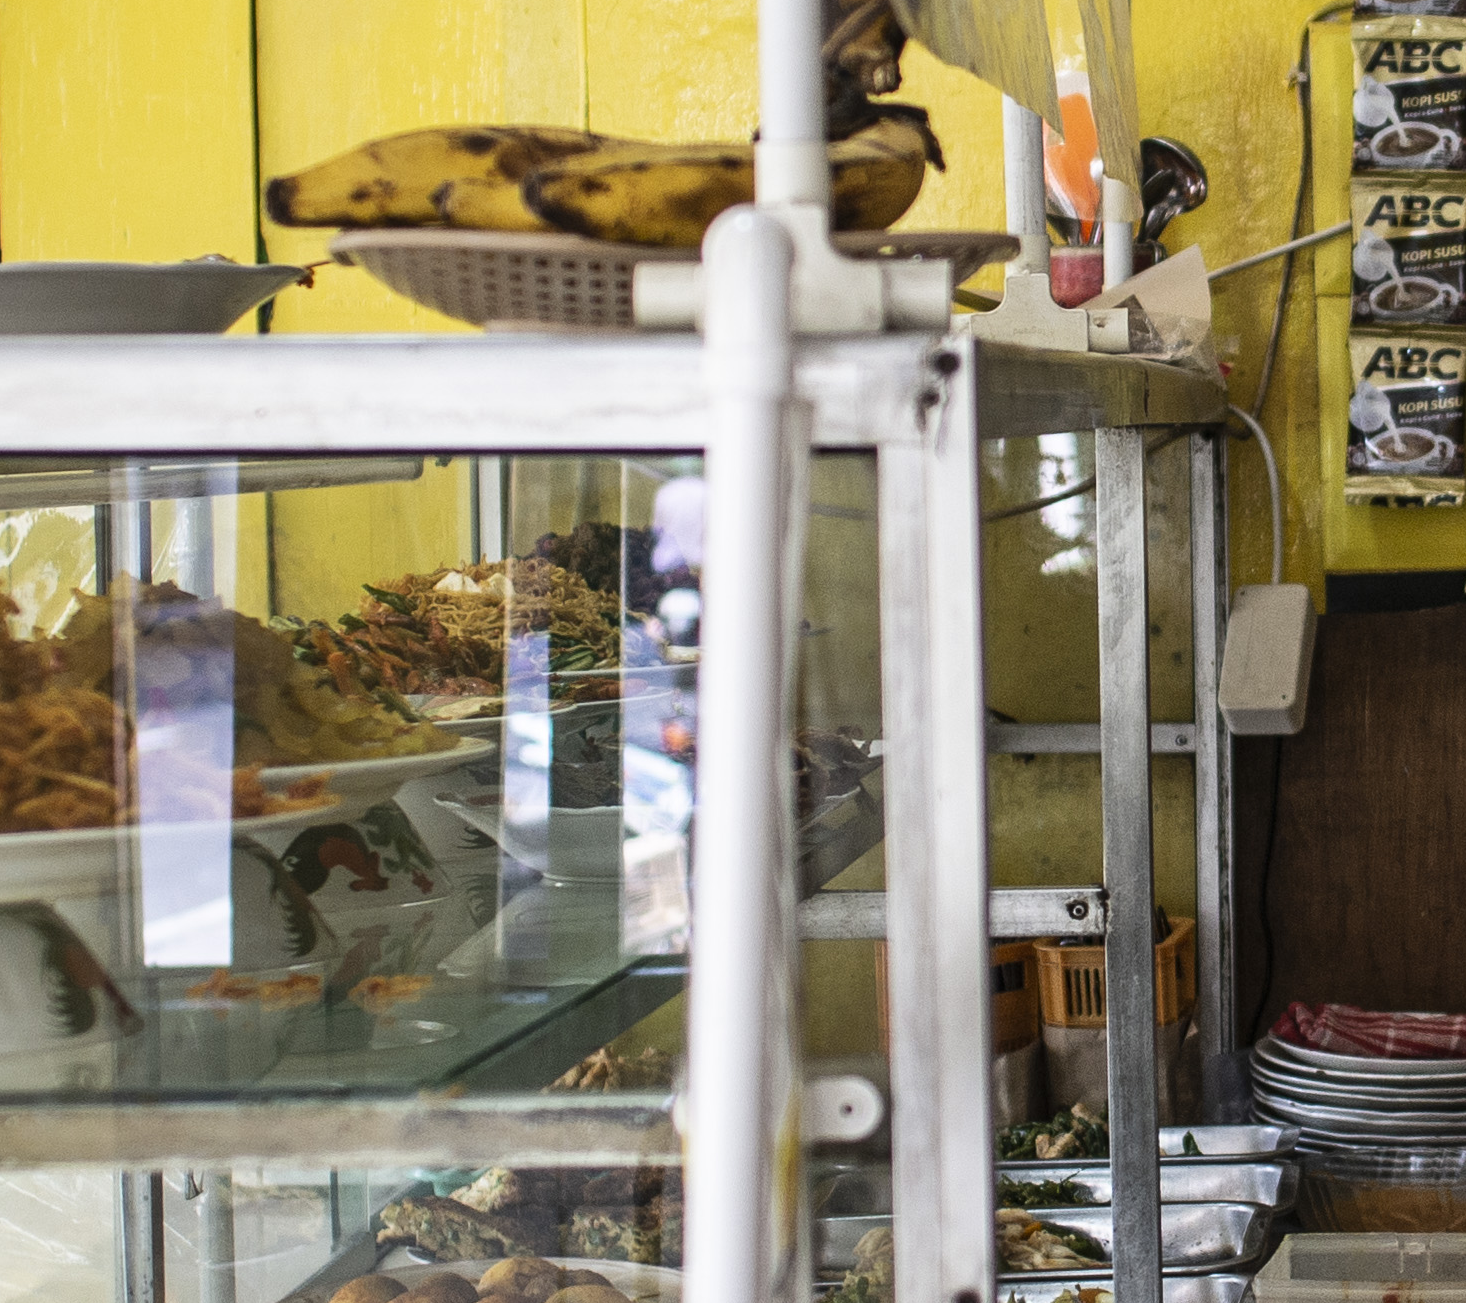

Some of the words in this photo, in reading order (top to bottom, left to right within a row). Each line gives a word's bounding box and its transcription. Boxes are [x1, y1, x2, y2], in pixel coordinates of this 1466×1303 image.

[1366, 41, 1464, 74] ABC
[1401, 95, 1432, 109] KOPI
[1364, 195, 1466, 228] ABC
[1401, 249, 1432, 263] KOPI
[1434, 244, 1466, 259] SUSU
[1361, 346, 1462, 380] ABC
[1398, 400, 1429, 415] KOPI
[1431, 395, 1463, 410] SUSU
